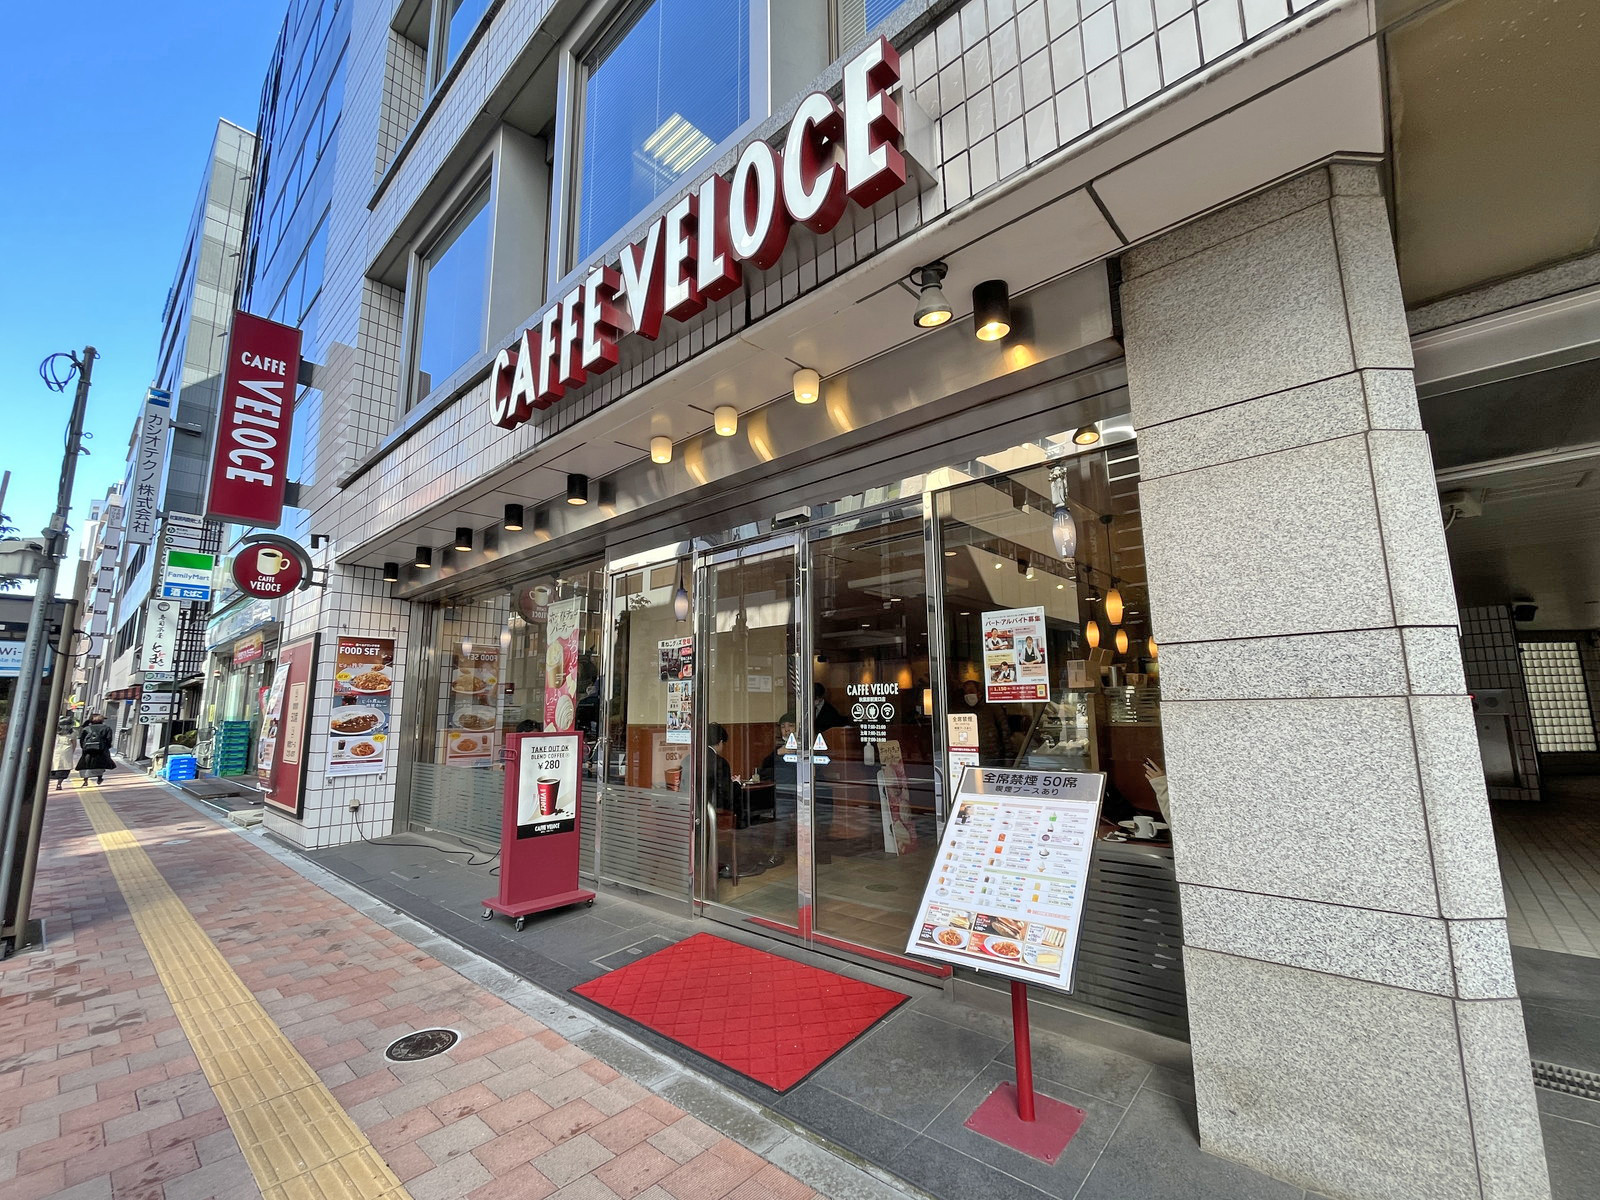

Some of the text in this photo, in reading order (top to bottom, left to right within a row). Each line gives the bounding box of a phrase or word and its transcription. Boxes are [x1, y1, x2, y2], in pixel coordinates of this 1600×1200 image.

[619, 35, 900, 340] VELOCE
[226, 380, 284, 487] VELOCE
[132, 413, 163, 535] カシオテクノ株式会社
[168, 572, 210, 583] FamilyMart
[250, 581, 282, 593] VELOCE
[170, 588, 203, 599] 酒 たばこ
[339, 646, 380, 657] FOOD SET
[870, 682, 899, 696] VELOCE
[537, 759, 560, 770] ¥280
[983, 772, 1078, 789] 全席禁煙 50席
[995, 786, 1059, 796] 喫煙ブースあり
